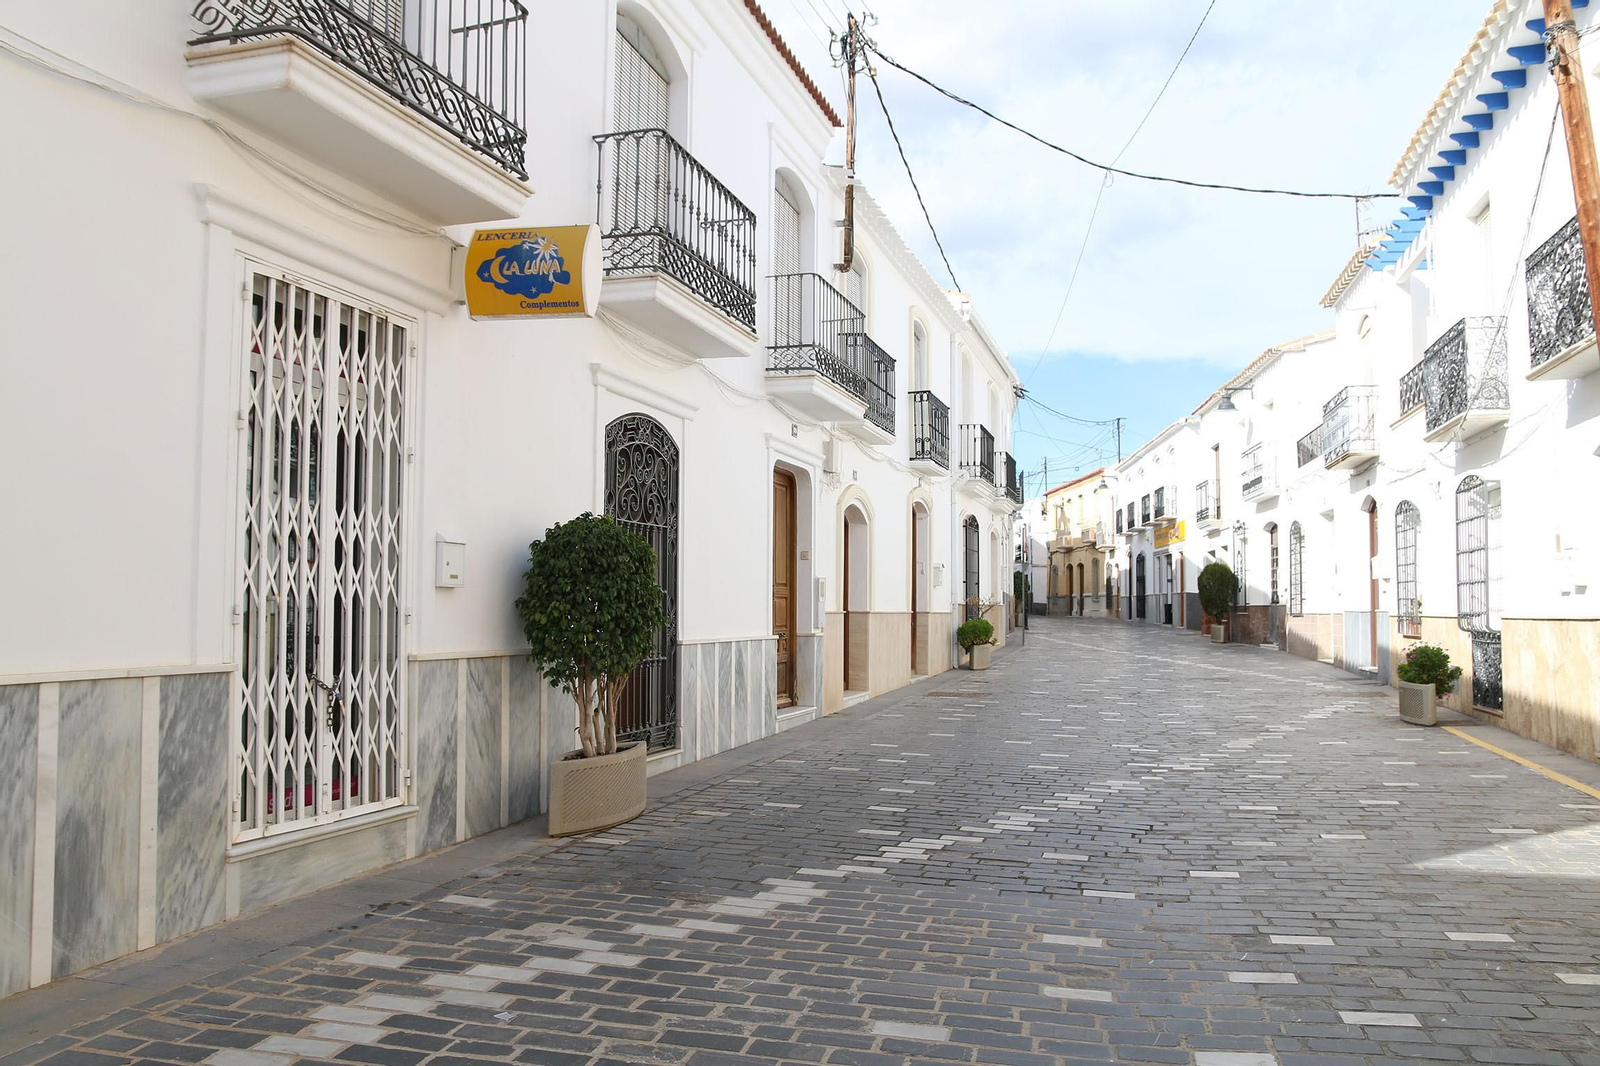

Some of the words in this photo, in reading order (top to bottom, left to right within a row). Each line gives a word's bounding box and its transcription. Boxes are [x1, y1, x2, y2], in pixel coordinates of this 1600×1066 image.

[502, 260, 520, 275] LA
[523, 258, 561, 276] LUNA
[520, 300, 580, 310] Complementos
